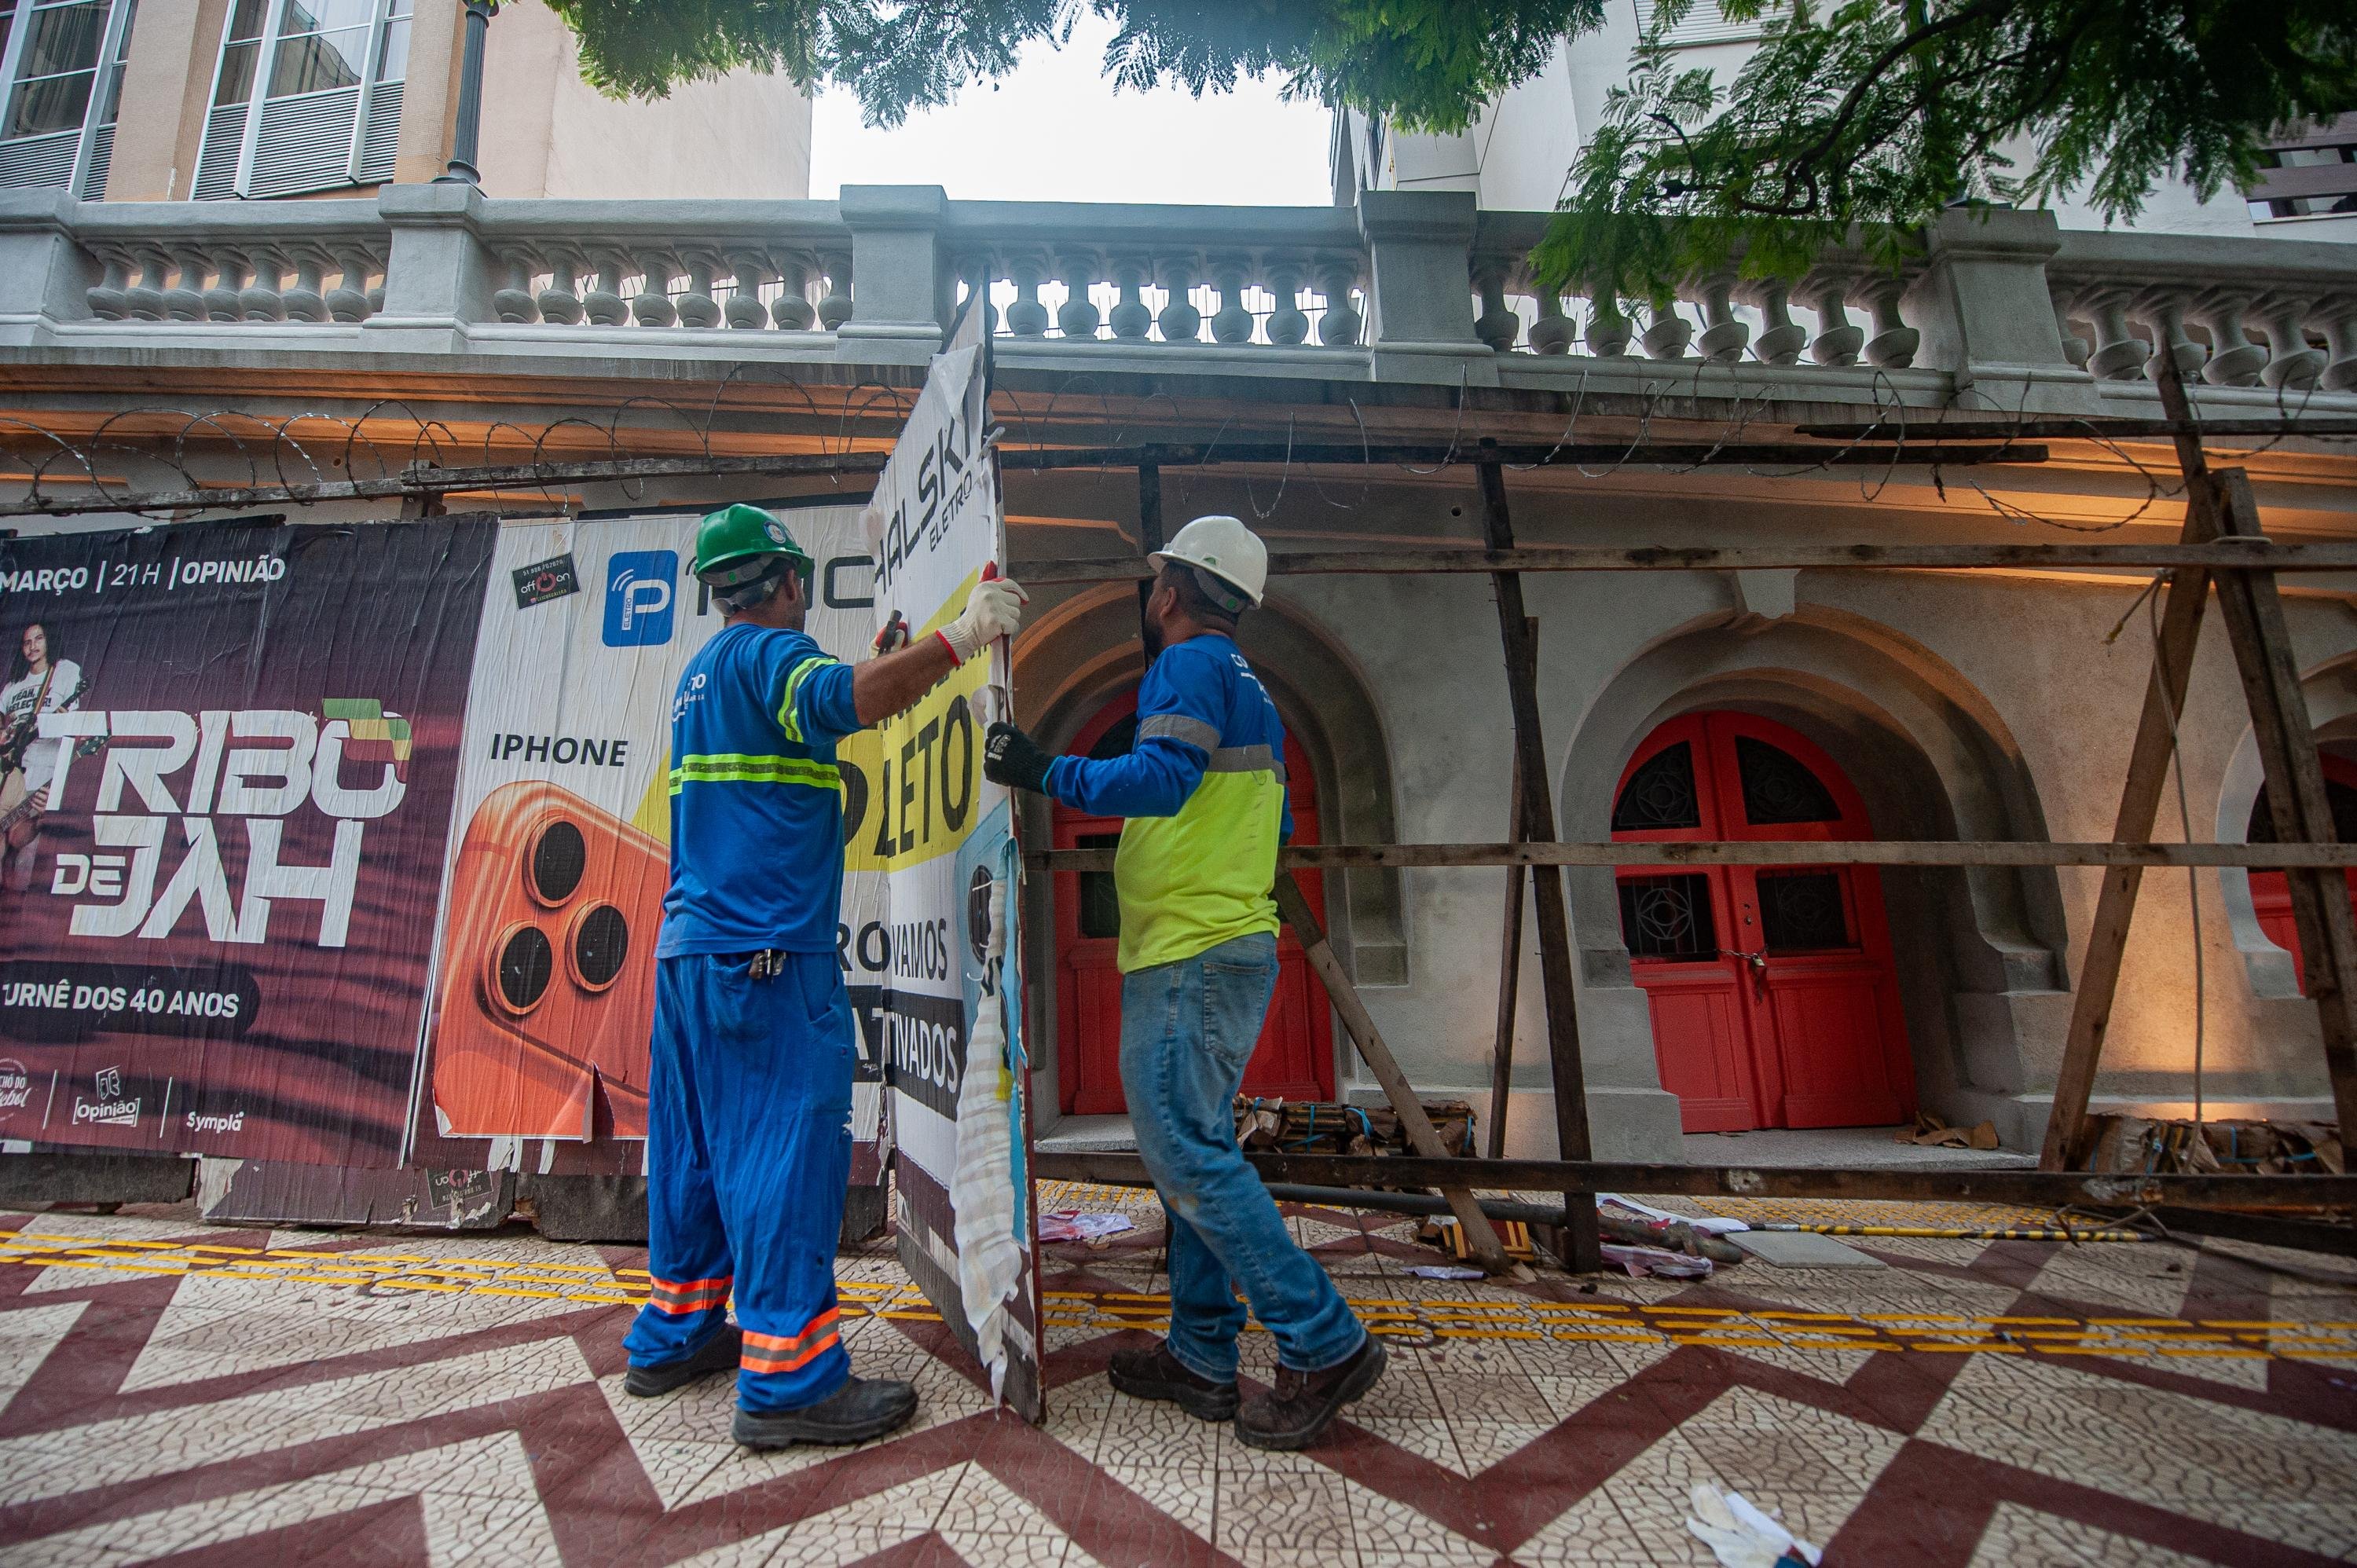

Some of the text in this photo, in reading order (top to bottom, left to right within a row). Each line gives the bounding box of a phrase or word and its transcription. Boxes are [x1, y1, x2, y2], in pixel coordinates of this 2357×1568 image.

[929, 470, 973, 552] ELETRO
[0, 554, 286, 595] MARÇO 21H OPINIÃO
[521, 573, 570, 594] off on
[623, 597, 632, 628] ELETRO
[38, 709, 412, 818] TRIBO
[491, 734, 629, 768] IPHONE
[51, 853, 126, 896] DE
[69, 815, 365, 947] JAH
[73, 984, 126, 1012] DOS
[130, 987, 165, 1013] 40
[167, 990, 239, 1018] ANOS
[77, 1100, 137, 1123] Opinião
